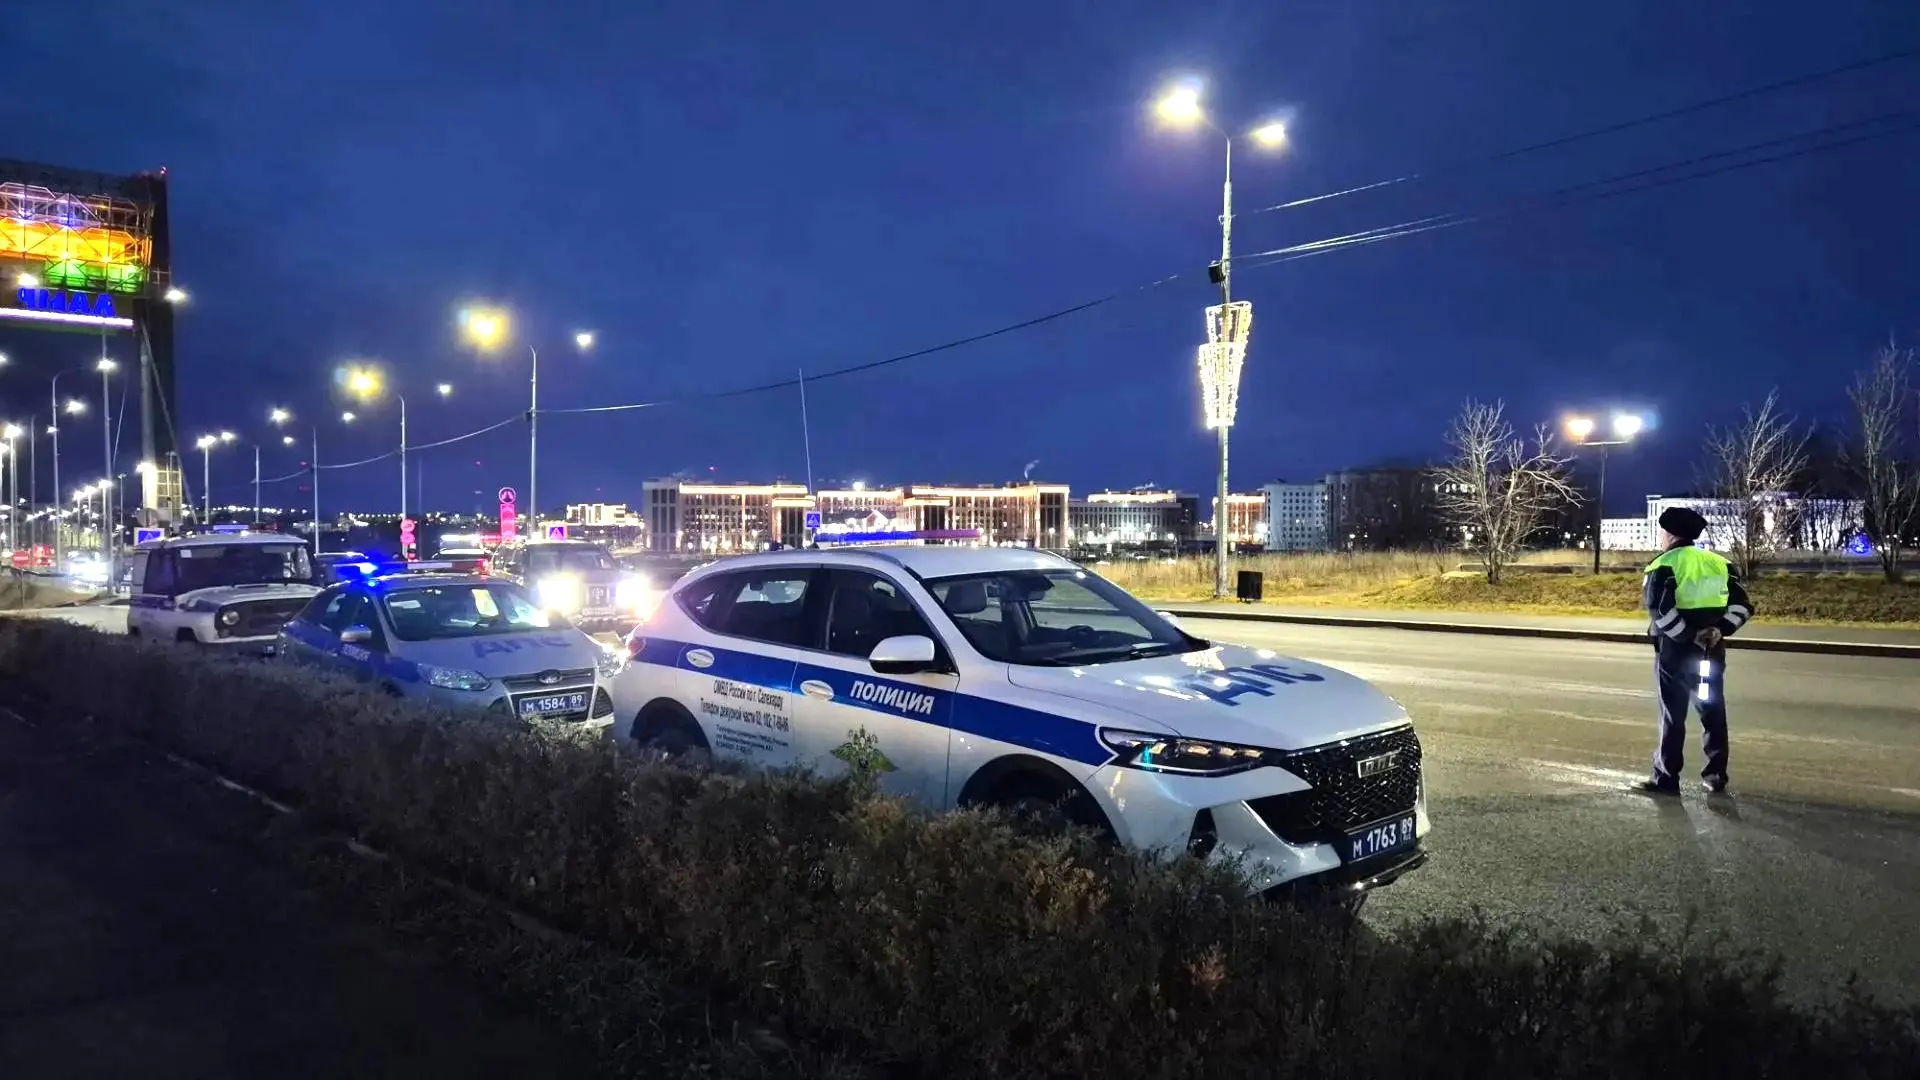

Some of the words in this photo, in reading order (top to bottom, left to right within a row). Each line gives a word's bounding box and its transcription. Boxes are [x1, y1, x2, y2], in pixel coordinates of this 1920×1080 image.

[471, 636, 573, 658] ДПС
[526, 702, 534, 712] М
[538, 696, 566, 711] 1584
[571, 694, 583, 704] 89
[850, 680, 935, 715] ПОЛИЦИЯ
[1185, 664, 1326, 707] ДПС
[1353, 839, 1362, 859] М
[1366, 823, 1397, 853] 1763
[1401, 816, 1413, 834] 89
